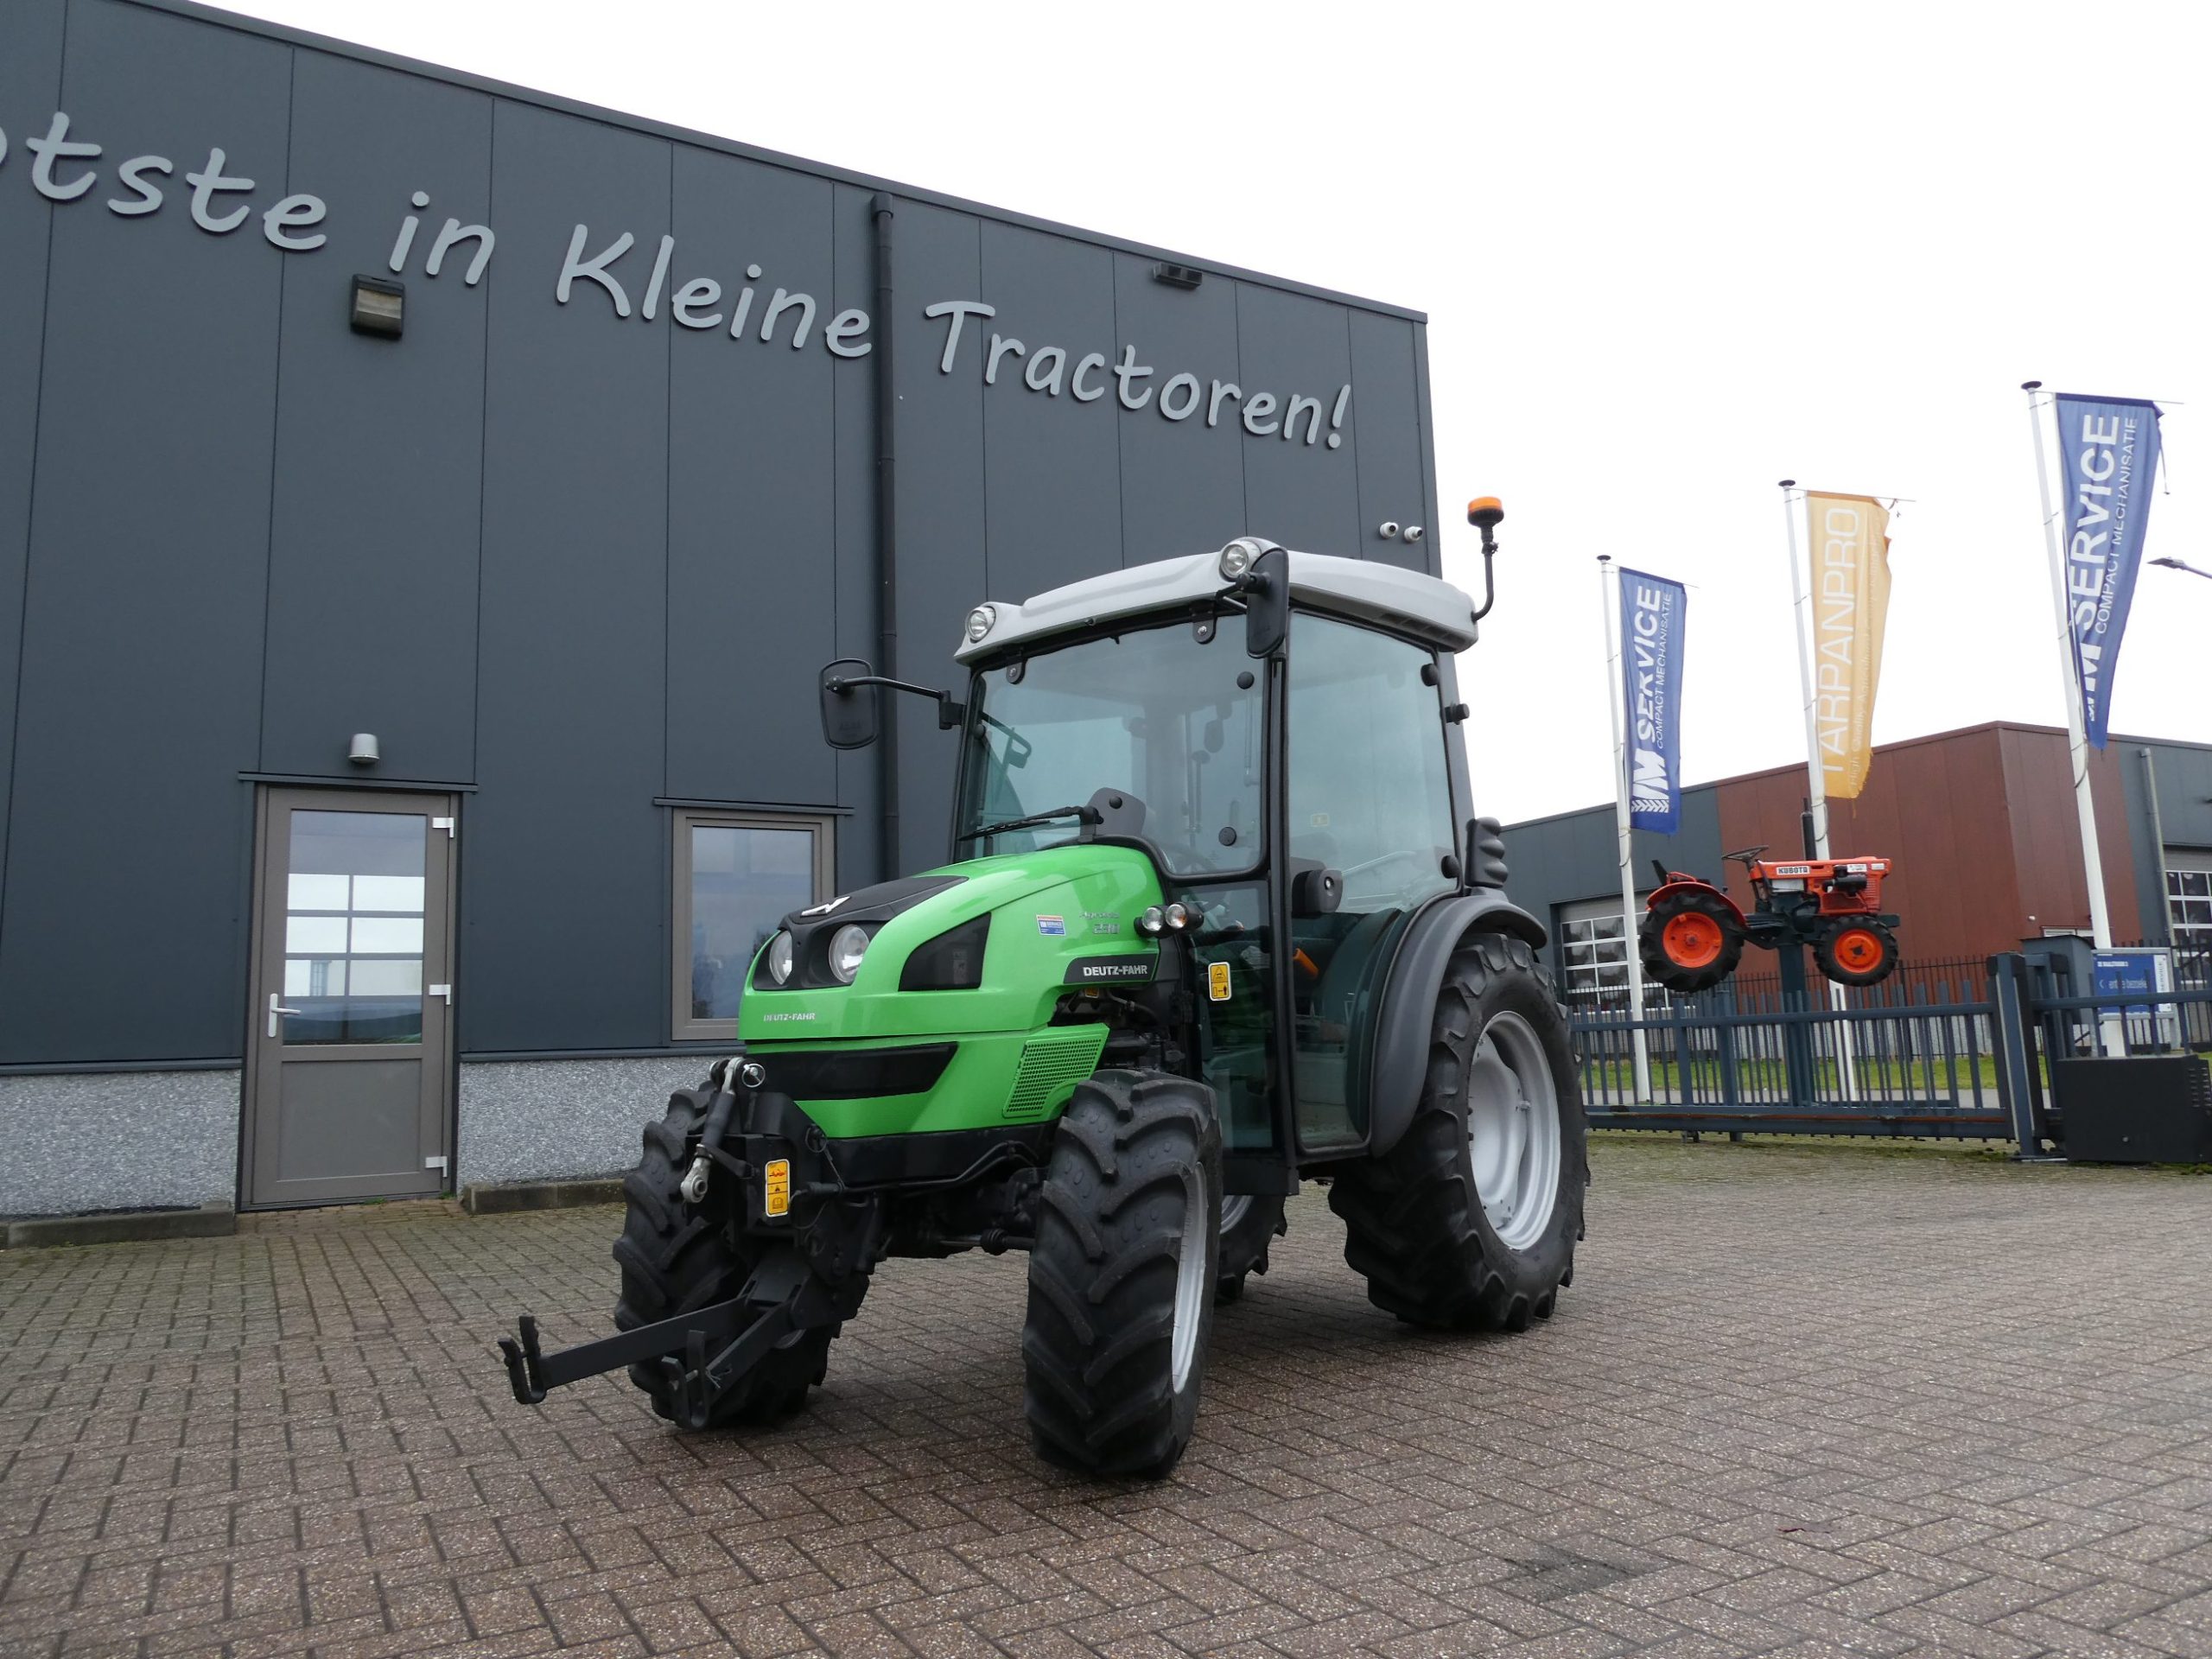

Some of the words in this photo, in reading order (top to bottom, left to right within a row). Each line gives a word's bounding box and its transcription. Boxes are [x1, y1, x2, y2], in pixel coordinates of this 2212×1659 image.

[0, 111, 327, 251] tste
[389, 190, 496, 285] in
[556, 223, 872, 359] Kleine
[925, 300, 1351, 449] Tractoren!
[2069, 414, 2120, 631] SERVICE
[1655, 592, 1672, 688] MECHANISATIE
[2094, 553, 2120, 634] COMPACT
[1633, 585, 1661, 744] SERVICE
[1652, 690, 1666, 750] COMPACT
[1082, 964, 1148, 976] DEUTZ-FAHR
